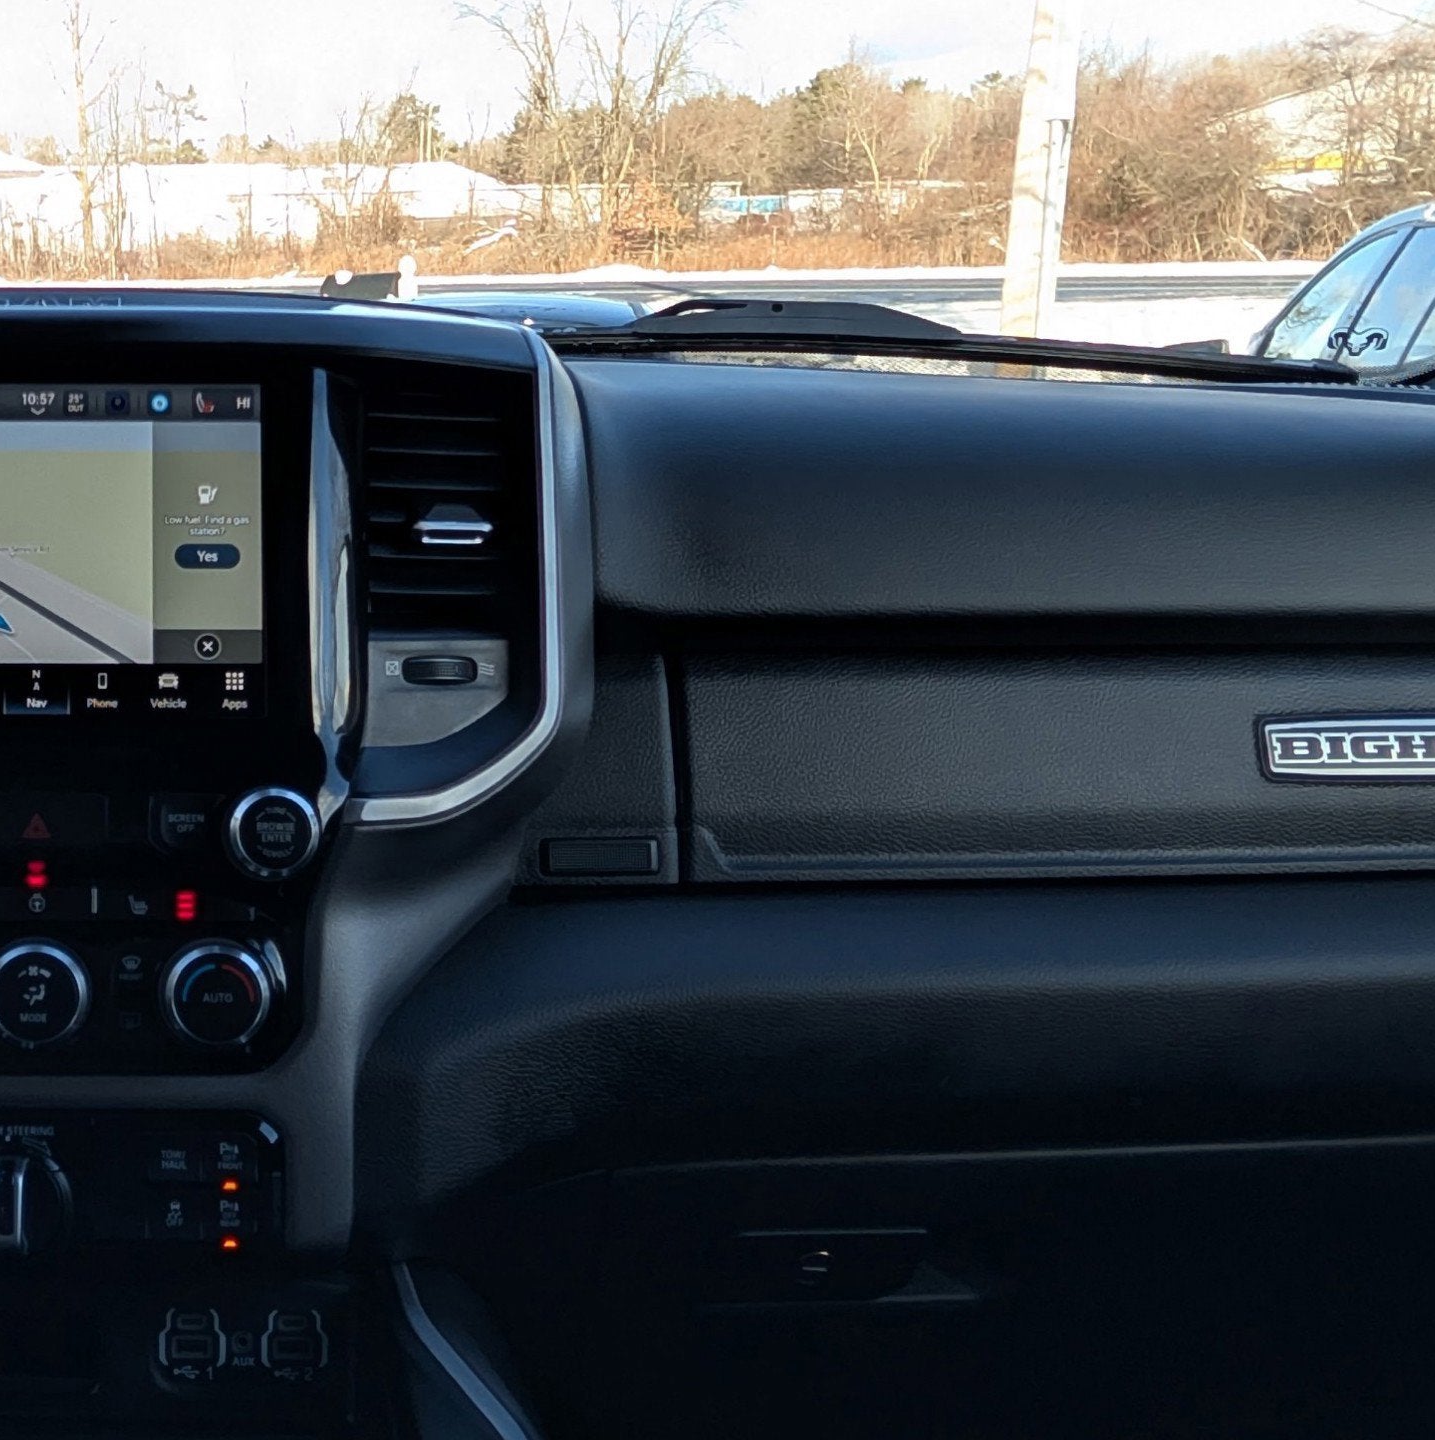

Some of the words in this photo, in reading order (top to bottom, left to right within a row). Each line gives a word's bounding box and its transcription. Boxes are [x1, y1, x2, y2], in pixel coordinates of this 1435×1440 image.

[22, 392, 55, 406] 10:57
[236, 397, 251, 410] HI
[164, 515, 182, 525] Low
[205, 515, 225, 525] Find
[232, 517, 250, 527] gas
[189, 526, 226, 536] station?
[197, 550, 219, 563] Yes
[26, 697, 48, 708] Nav
[86, 697, 119, 708] Phone
[150, 696, 188, 708] Vehicle
[222, 697, 249, 712] Apps
[168, 813, 205, 823] SCREEN
[177, 824, 194, 833] OFF
[256, 822, 295, 833] BROWSE
[261, 833, 292, 843] ENTER
[203, 992, 233, 1003] AUTO
[19, 1013, 47, 1023] MODE
[7, 1126, 55, 1137] STEERING
[161, 1149, 187, 1160] TOW/
[161, 1160, 187, 1171] HAUL
[166, 1217, 183, 1228] OFF
[232, 1357, 256, 1367] AUX
[206, 1366, 213, 1380] 1
[304, 1366, 314, 1381] 2
